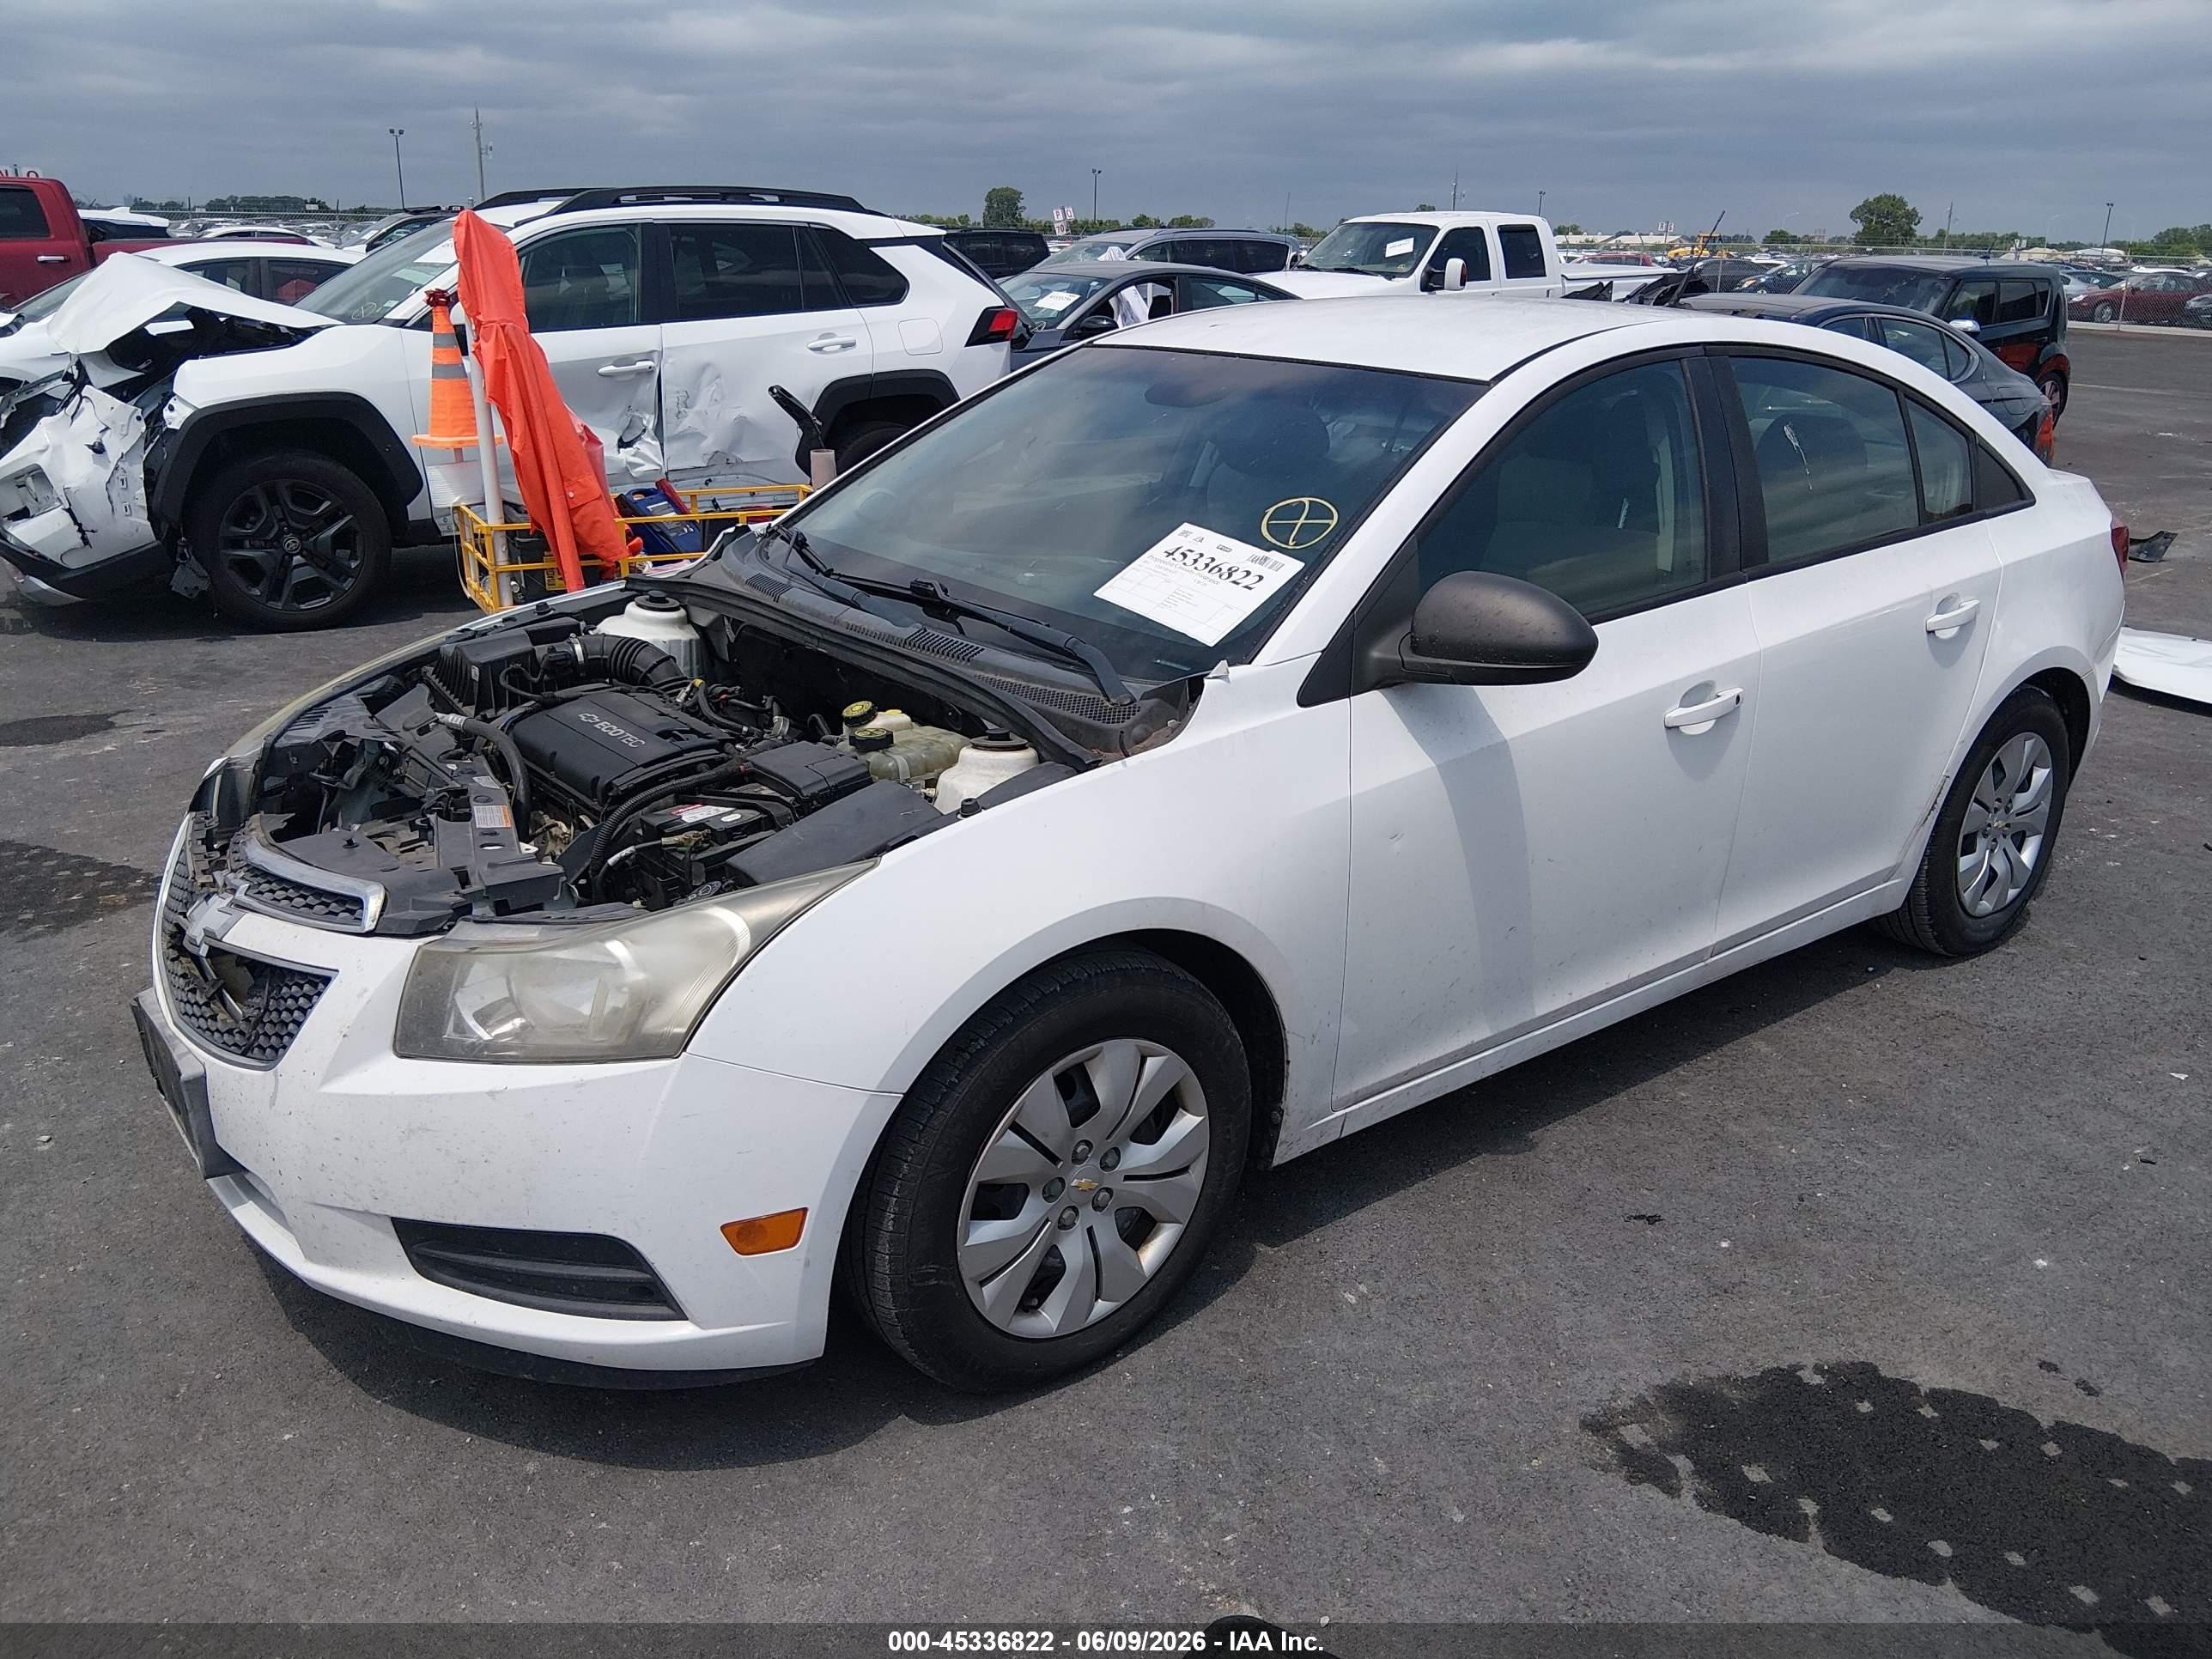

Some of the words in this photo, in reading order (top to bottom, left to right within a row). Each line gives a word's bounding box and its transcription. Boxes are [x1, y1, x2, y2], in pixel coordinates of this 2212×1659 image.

[1055, 223, 1065, 234] 70
[1163, 544, 1265, 591] 45336822
[593, 720, 647, 748] ECOTEC
